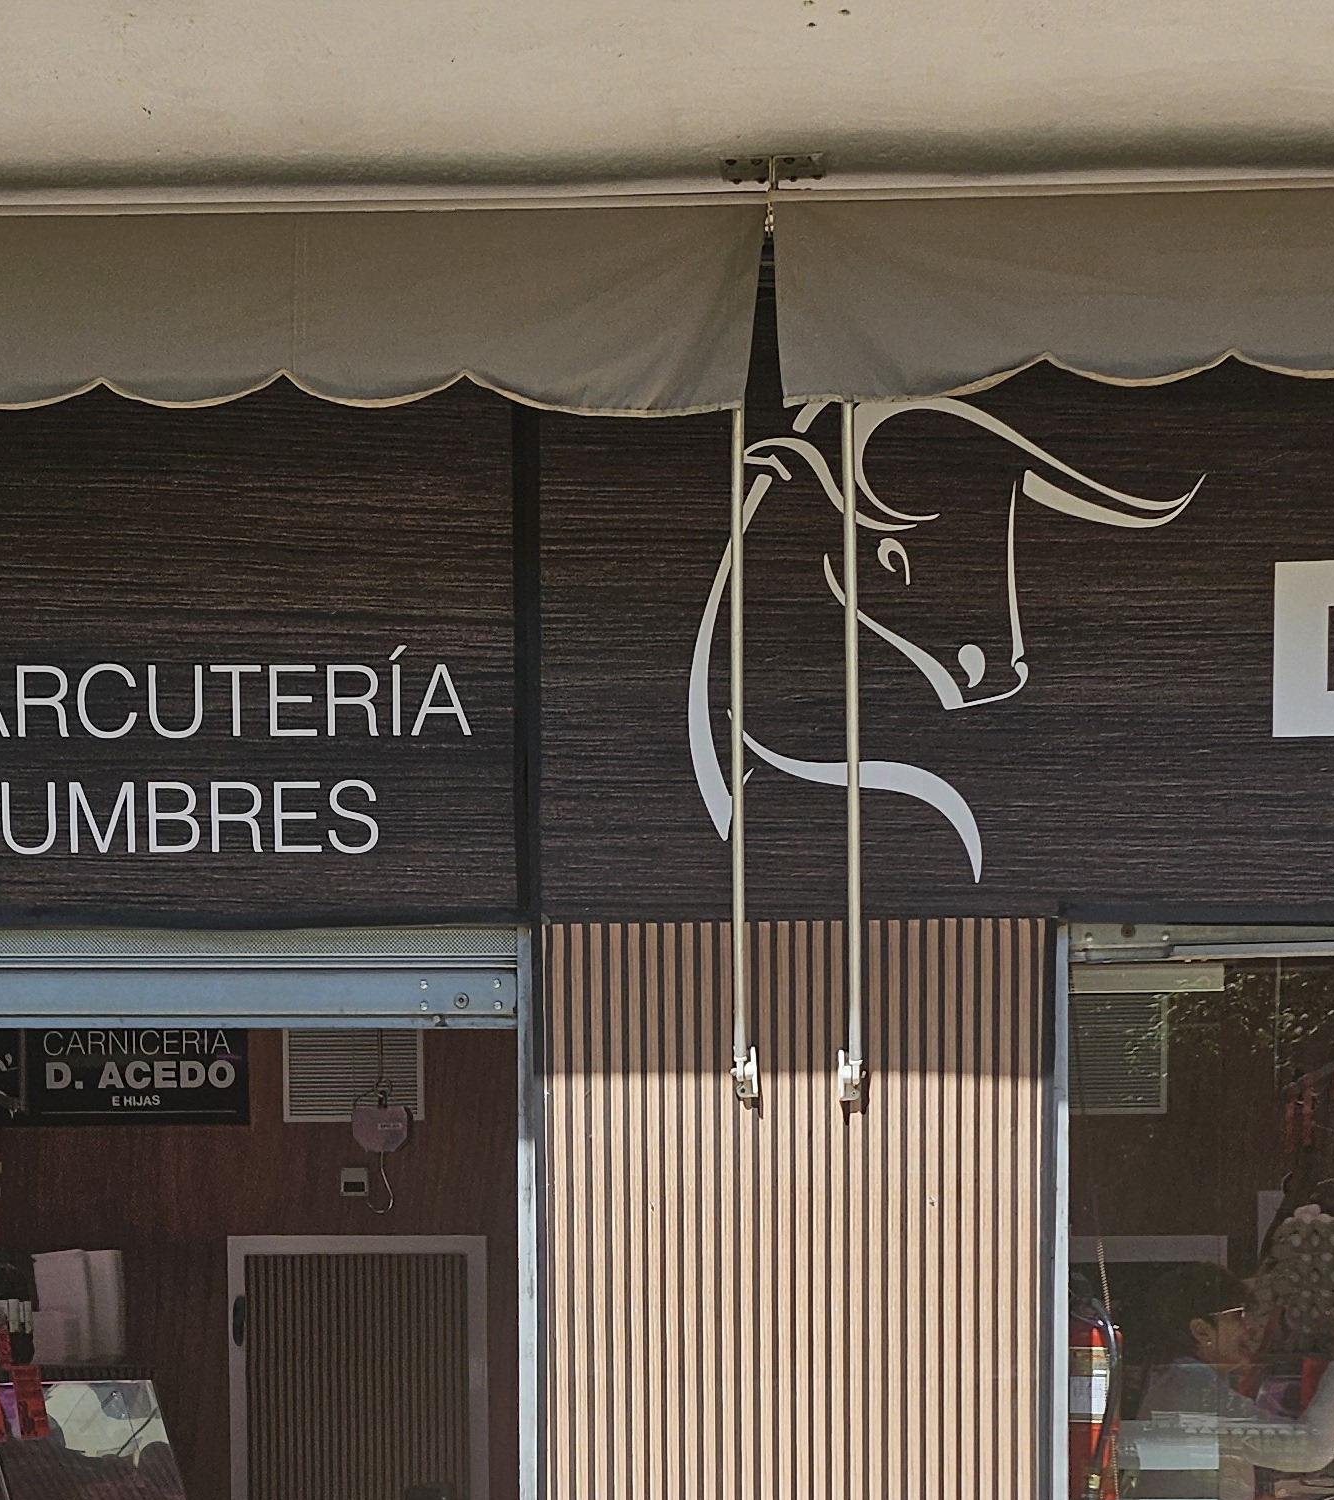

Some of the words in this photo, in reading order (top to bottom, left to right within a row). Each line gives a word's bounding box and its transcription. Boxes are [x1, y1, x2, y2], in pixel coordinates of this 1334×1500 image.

[45, 1061, 84, 1089] D.
[98, 1059, 236, 1089] ACEDO
[112, 1095, 121, 1107] E
[123, 1094, 161, 1107] HIJAS
